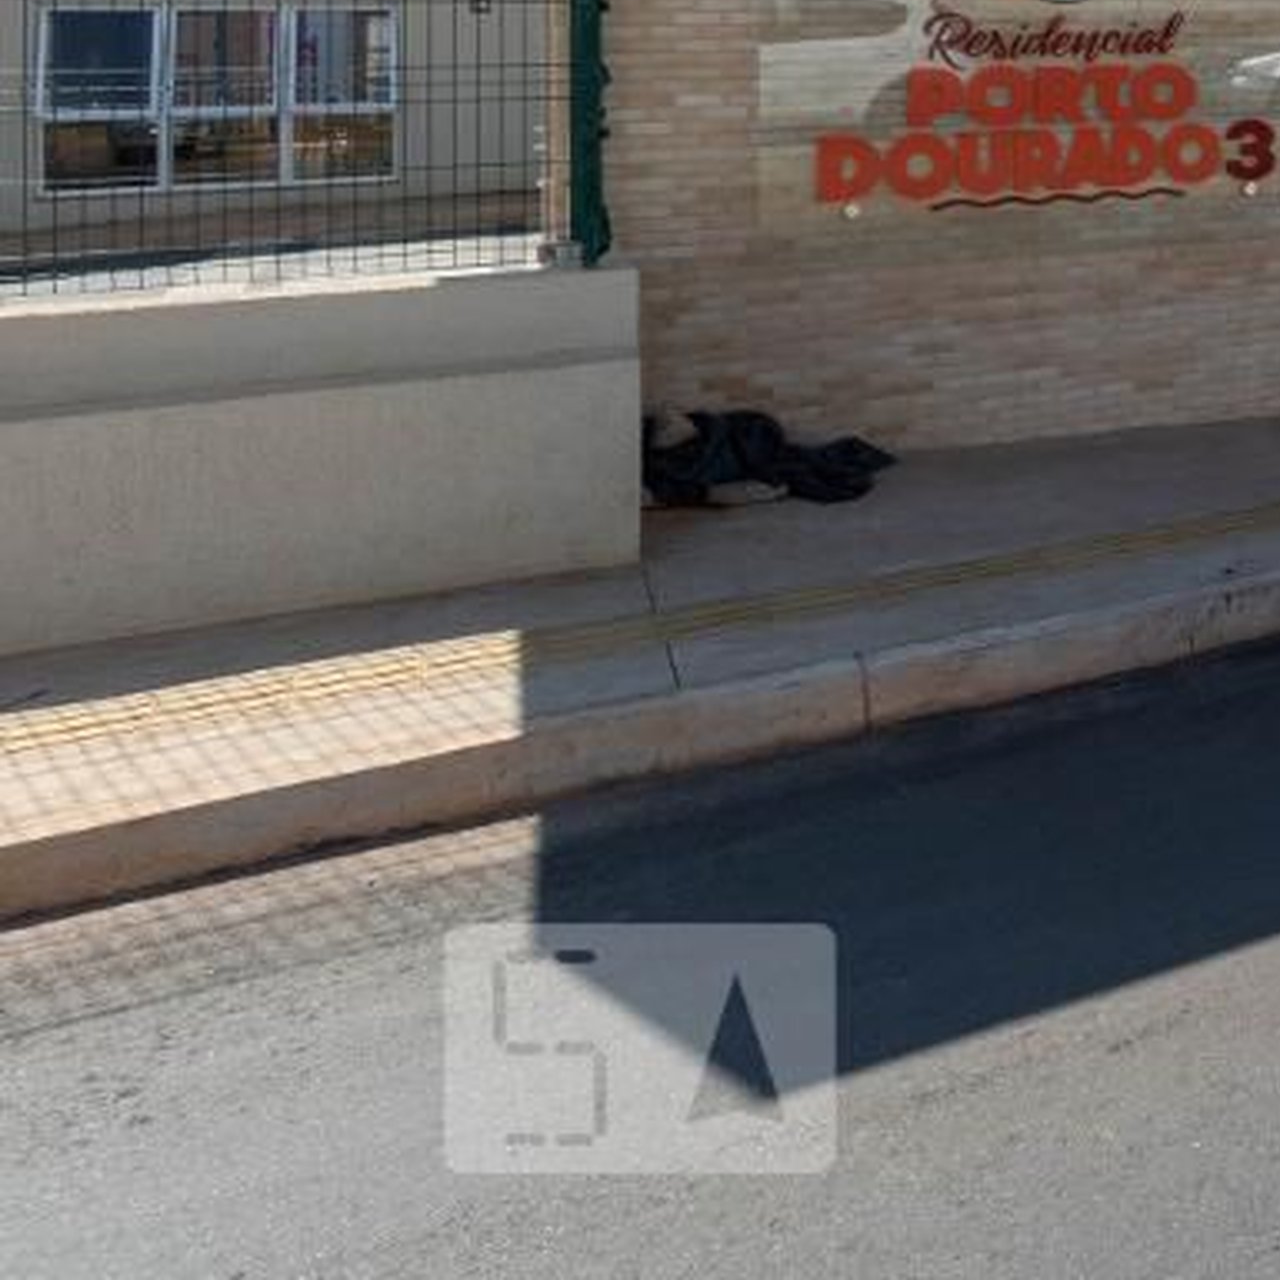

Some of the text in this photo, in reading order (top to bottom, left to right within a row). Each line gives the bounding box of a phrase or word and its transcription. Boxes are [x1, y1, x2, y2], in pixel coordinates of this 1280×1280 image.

[924, 10, 1184, 68] Residencial
[906, 63, 1197, 126] PORTO
[815, 123, 1223, 202] DOURADO
